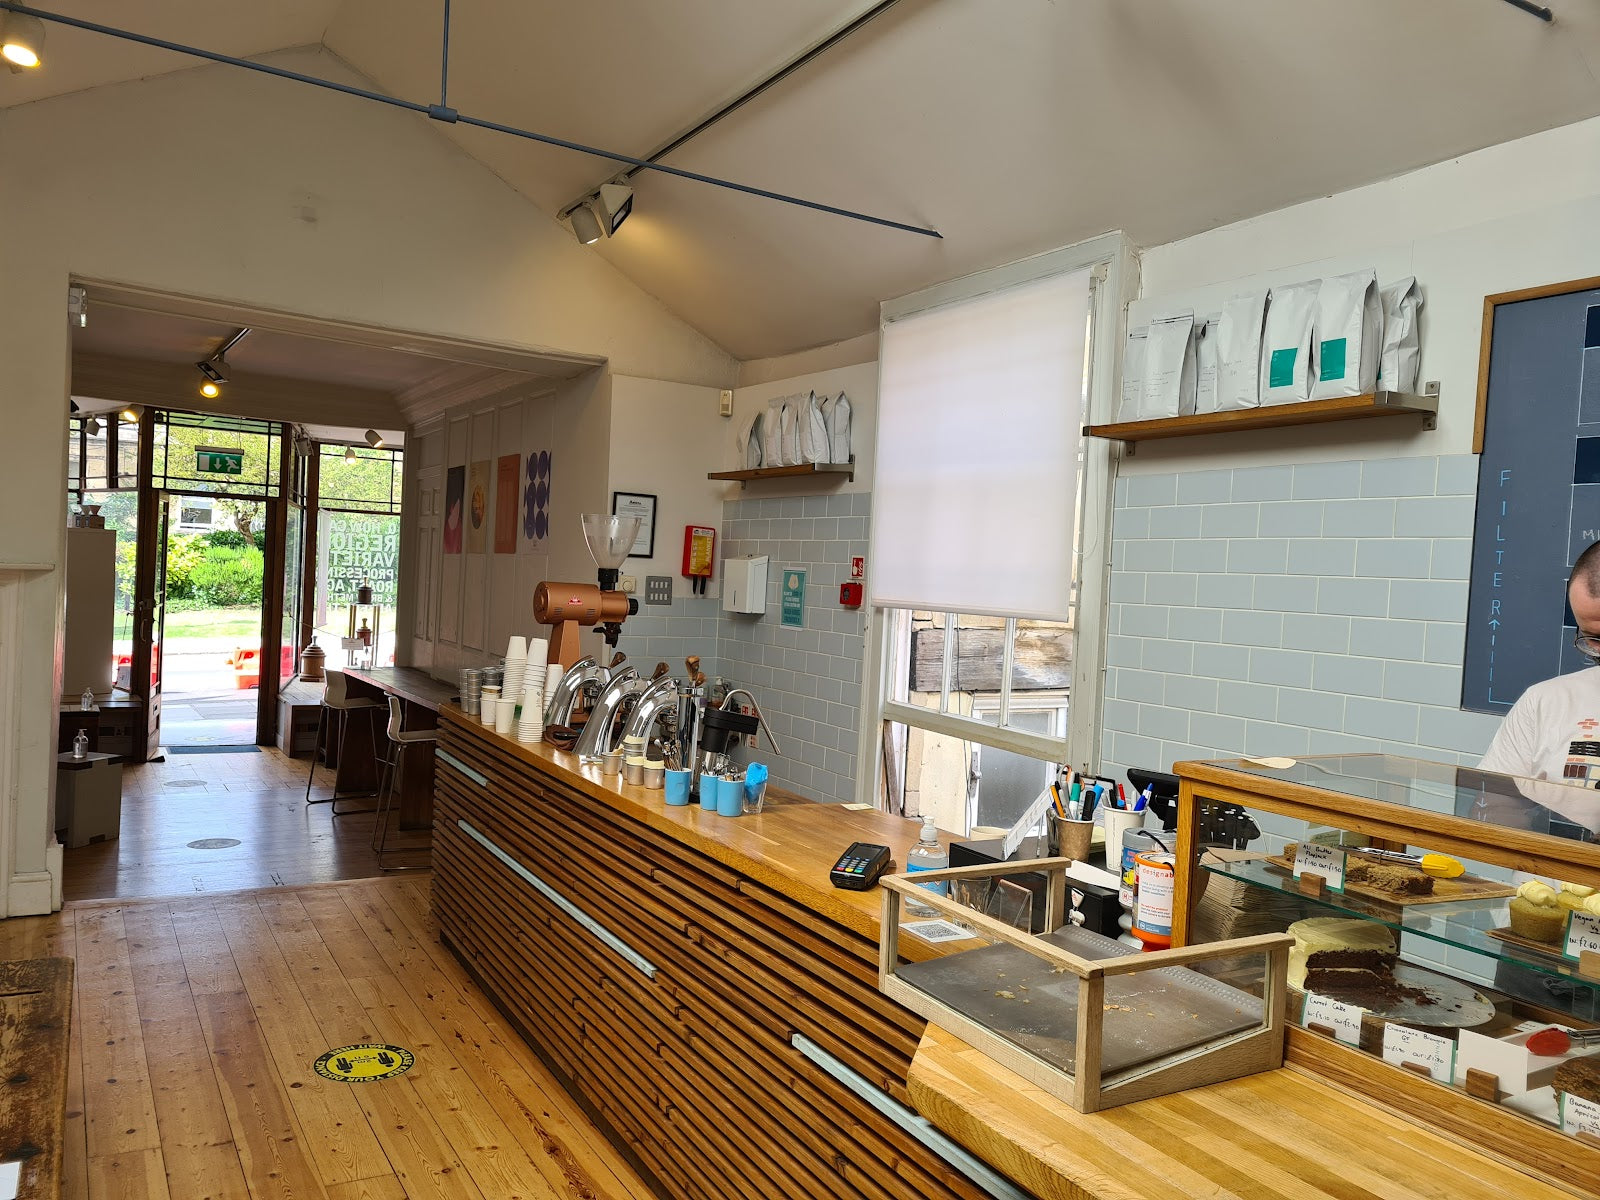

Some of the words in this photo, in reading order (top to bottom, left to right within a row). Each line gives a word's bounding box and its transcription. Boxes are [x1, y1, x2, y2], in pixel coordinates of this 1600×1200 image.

[1491, 469, 1512, 615] FILTER
[1142, 867, 1174, 879] designab
[1574, 912, 1594, 925] Vegan
[1332, 1002, 1346, 1013] Cake
